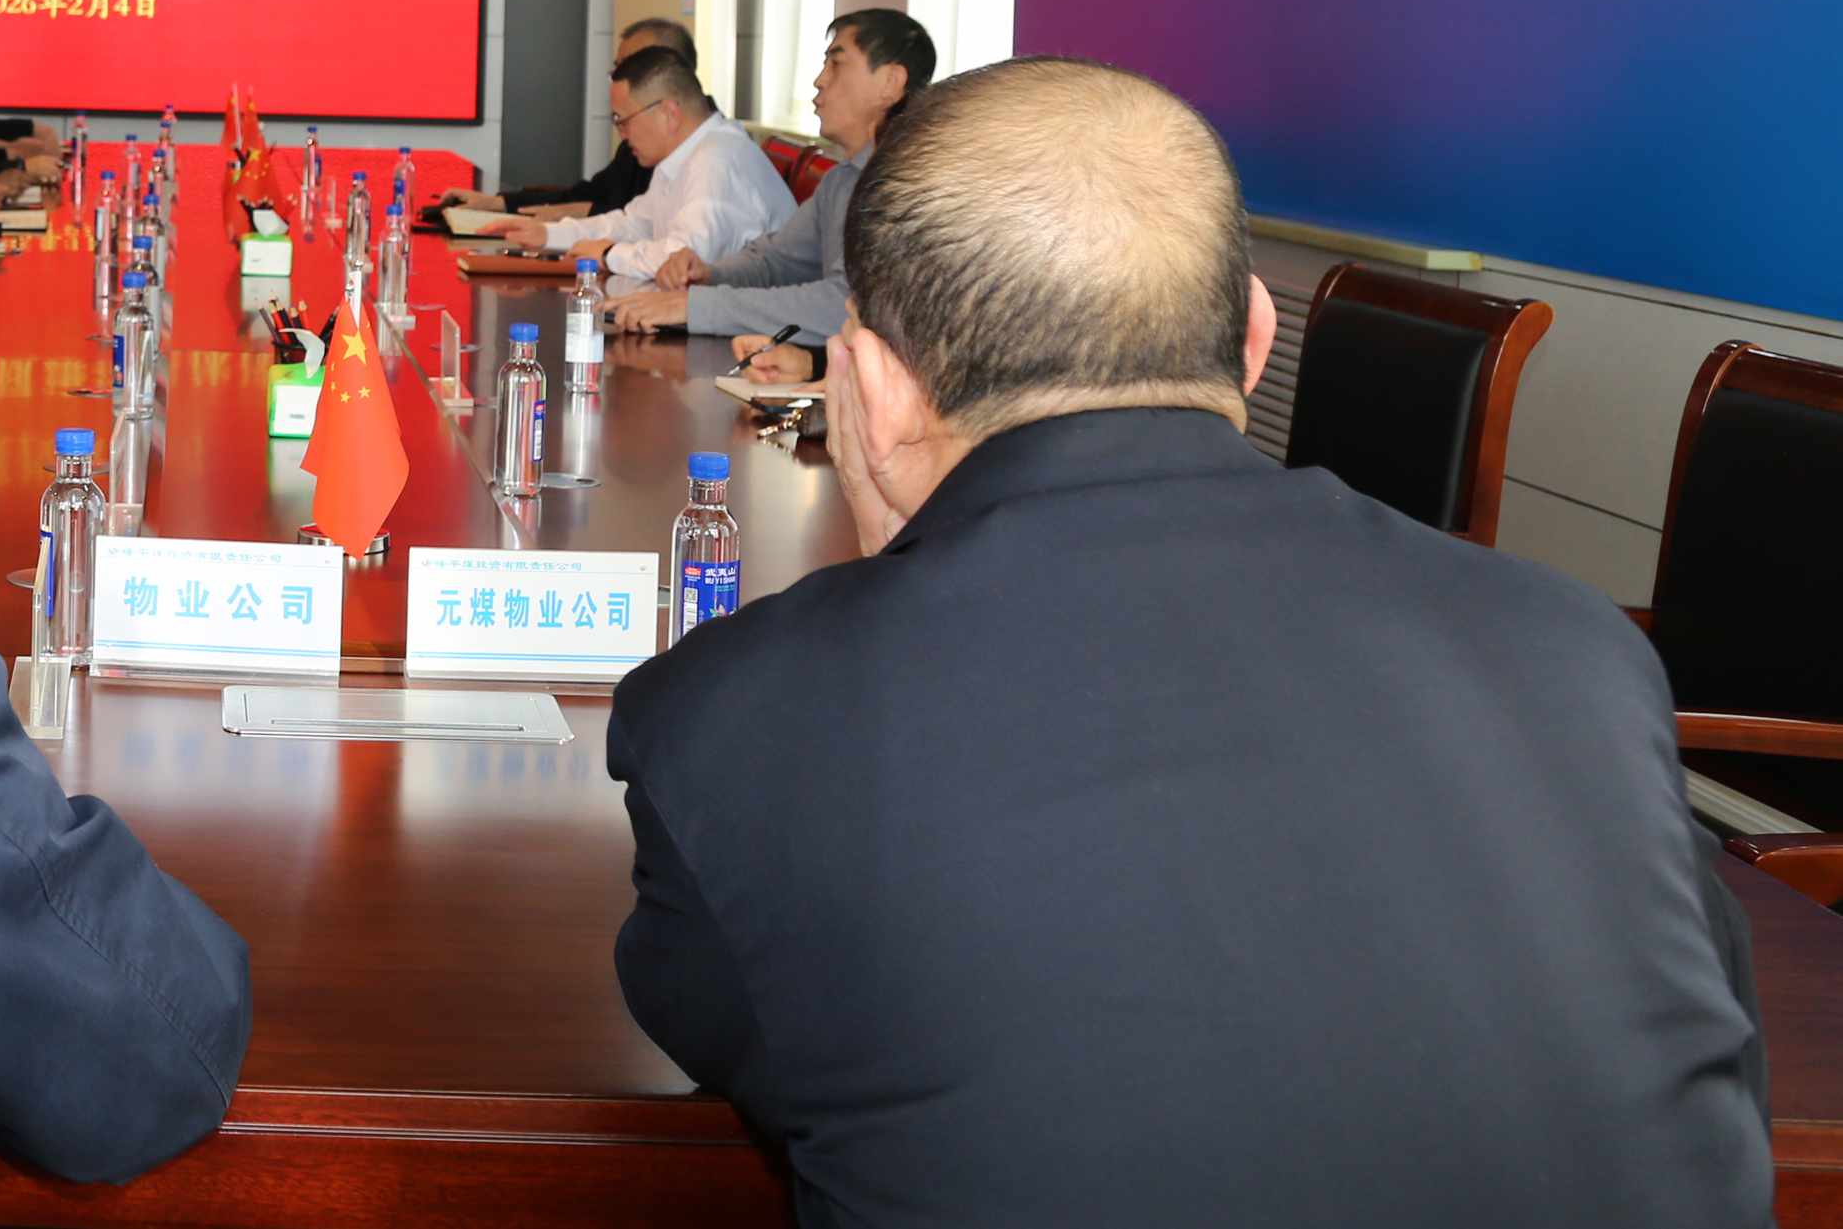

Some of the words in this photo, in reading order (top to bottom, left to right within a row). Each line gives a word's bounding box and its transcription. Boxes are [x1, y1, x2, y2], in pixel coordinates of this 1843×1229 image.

[123, 575, 314, 625] 物业公司
[436, 586, 631, 631] 元煤物业公司
